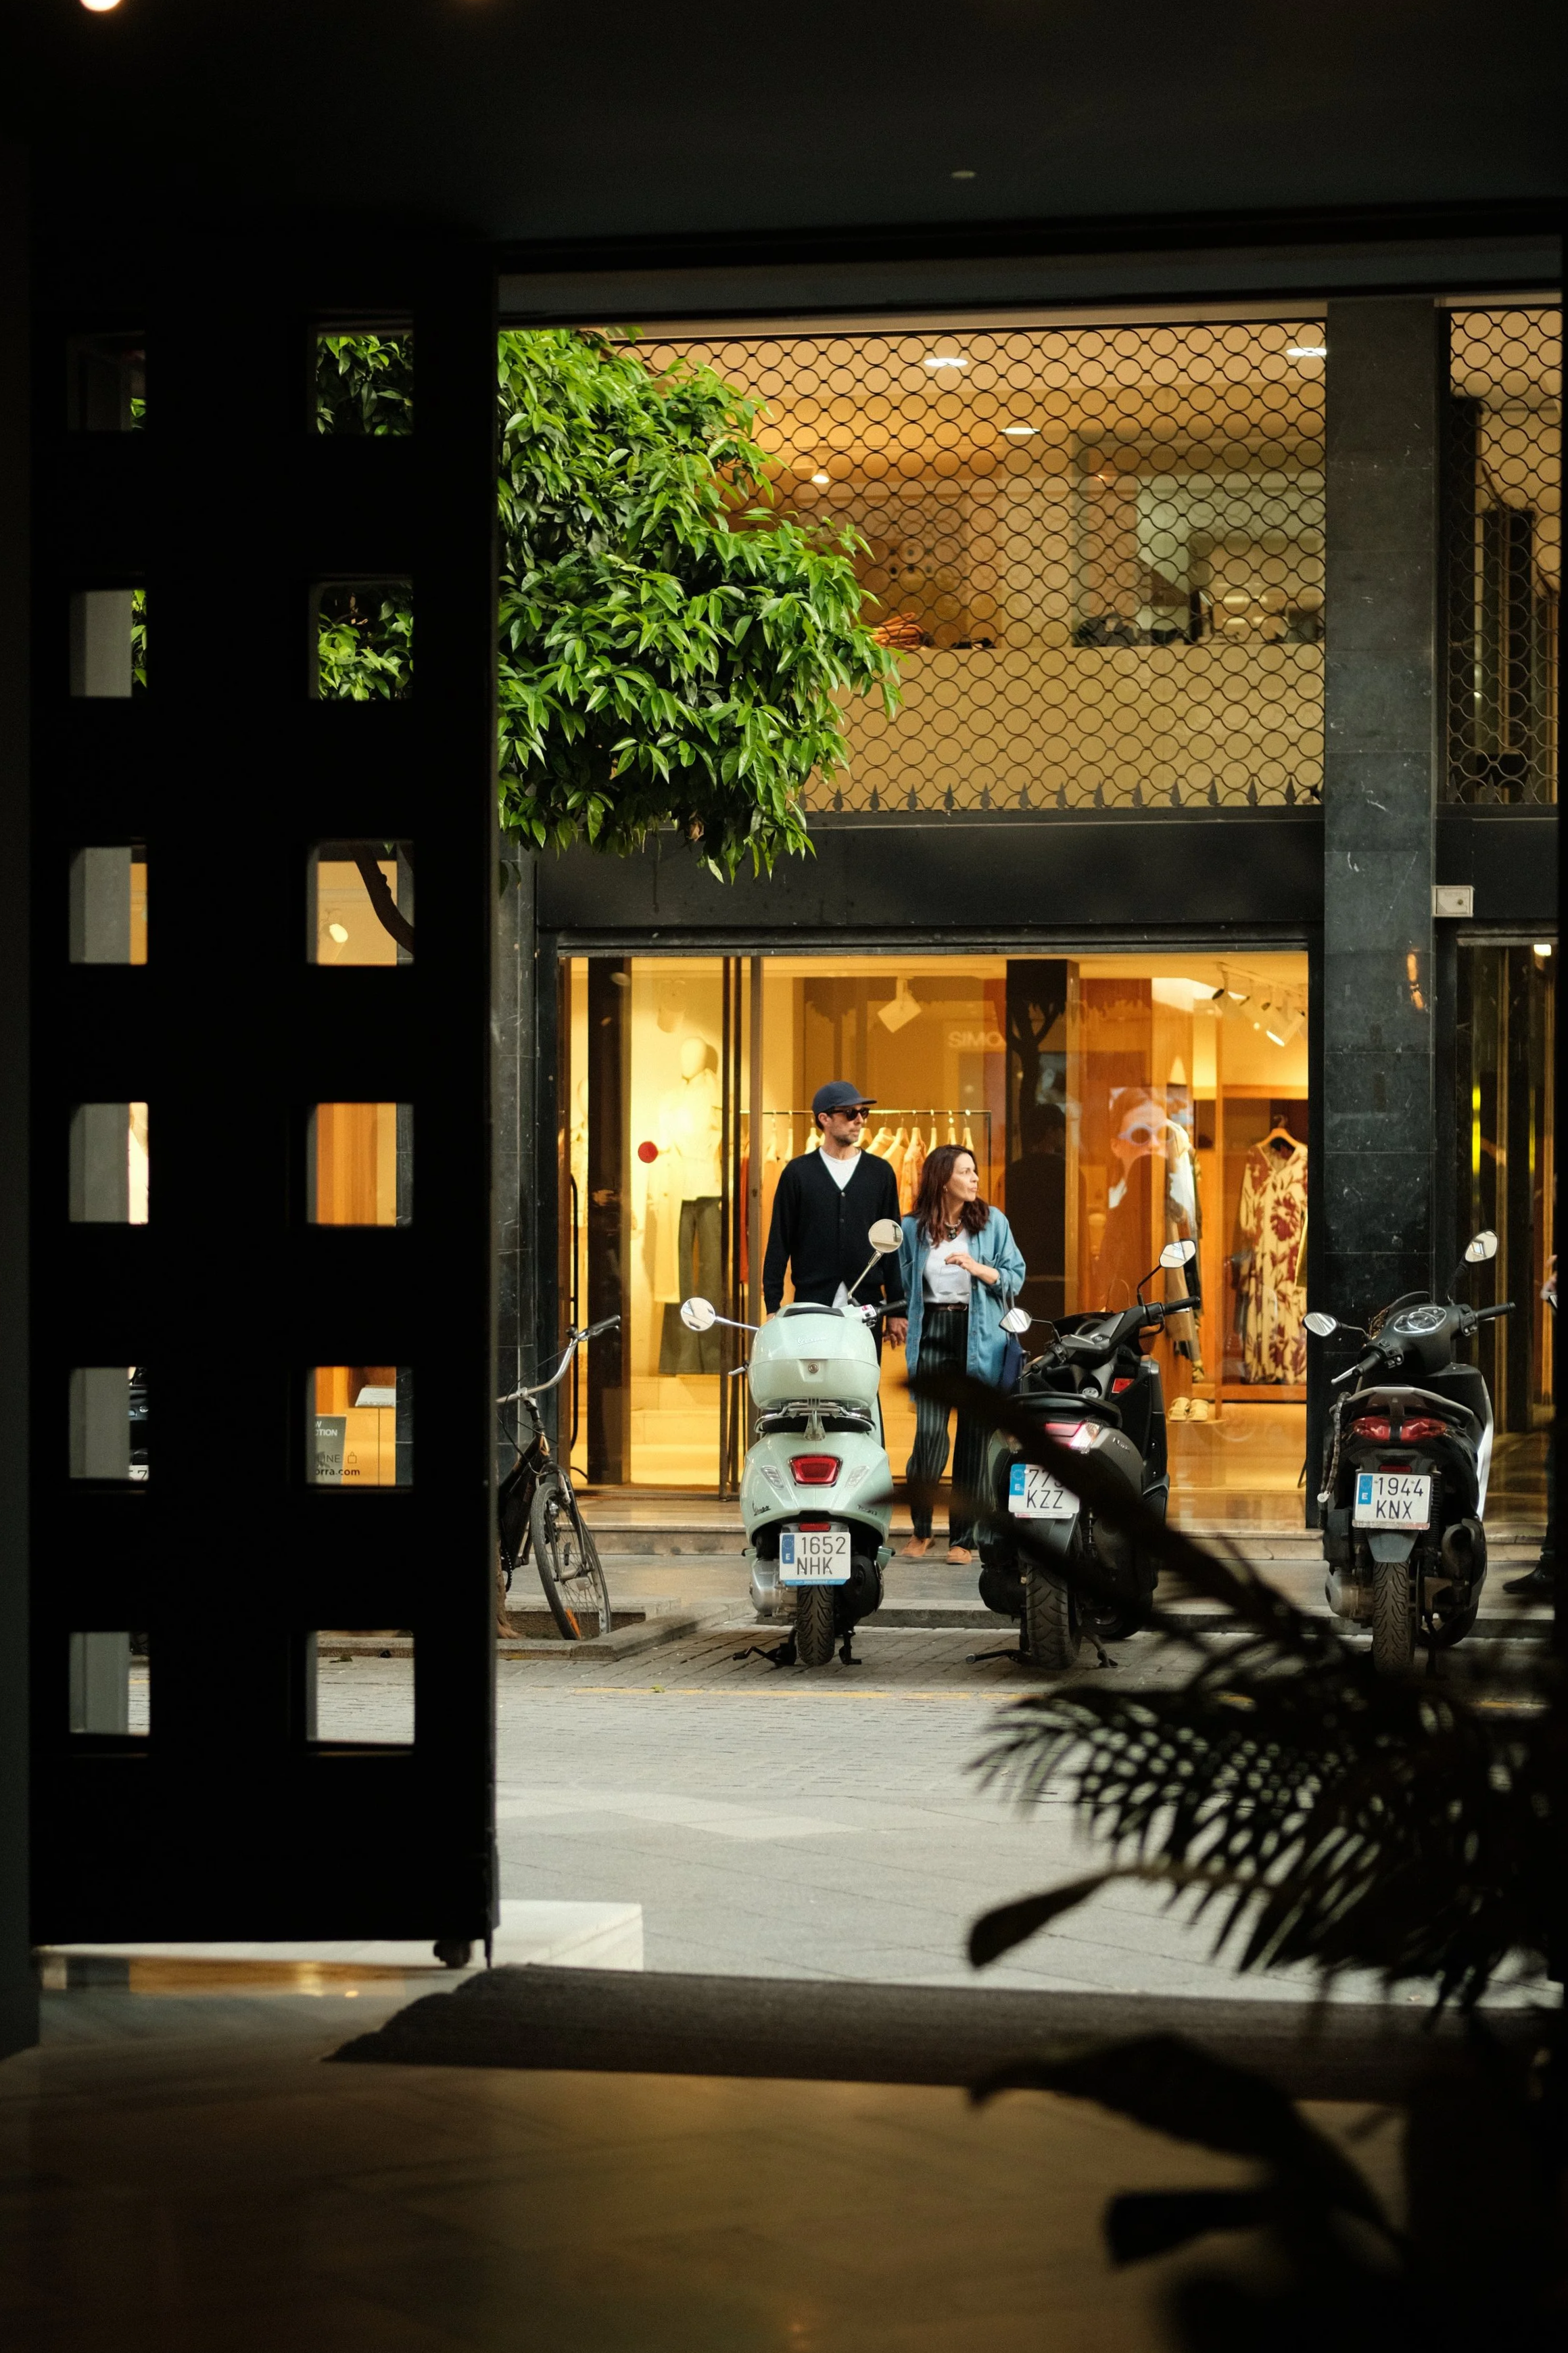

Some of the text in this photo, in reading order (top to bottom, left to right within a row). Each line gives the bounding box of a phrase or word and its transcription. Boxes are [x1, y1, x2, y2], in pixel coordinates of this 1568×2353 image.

[1014, 1483, 1021, 1491] E
[1361, 1492, 1369, 1500] E
[1379, 1476, 1423, 1497] 1944
[1026, 1489, 1064, 1509] KZZ
[1376, 1499, 1412, 1520] KNX
[801, 1536, 846, 1555] 1652
[797, 1557, 833, 1575] NHK
